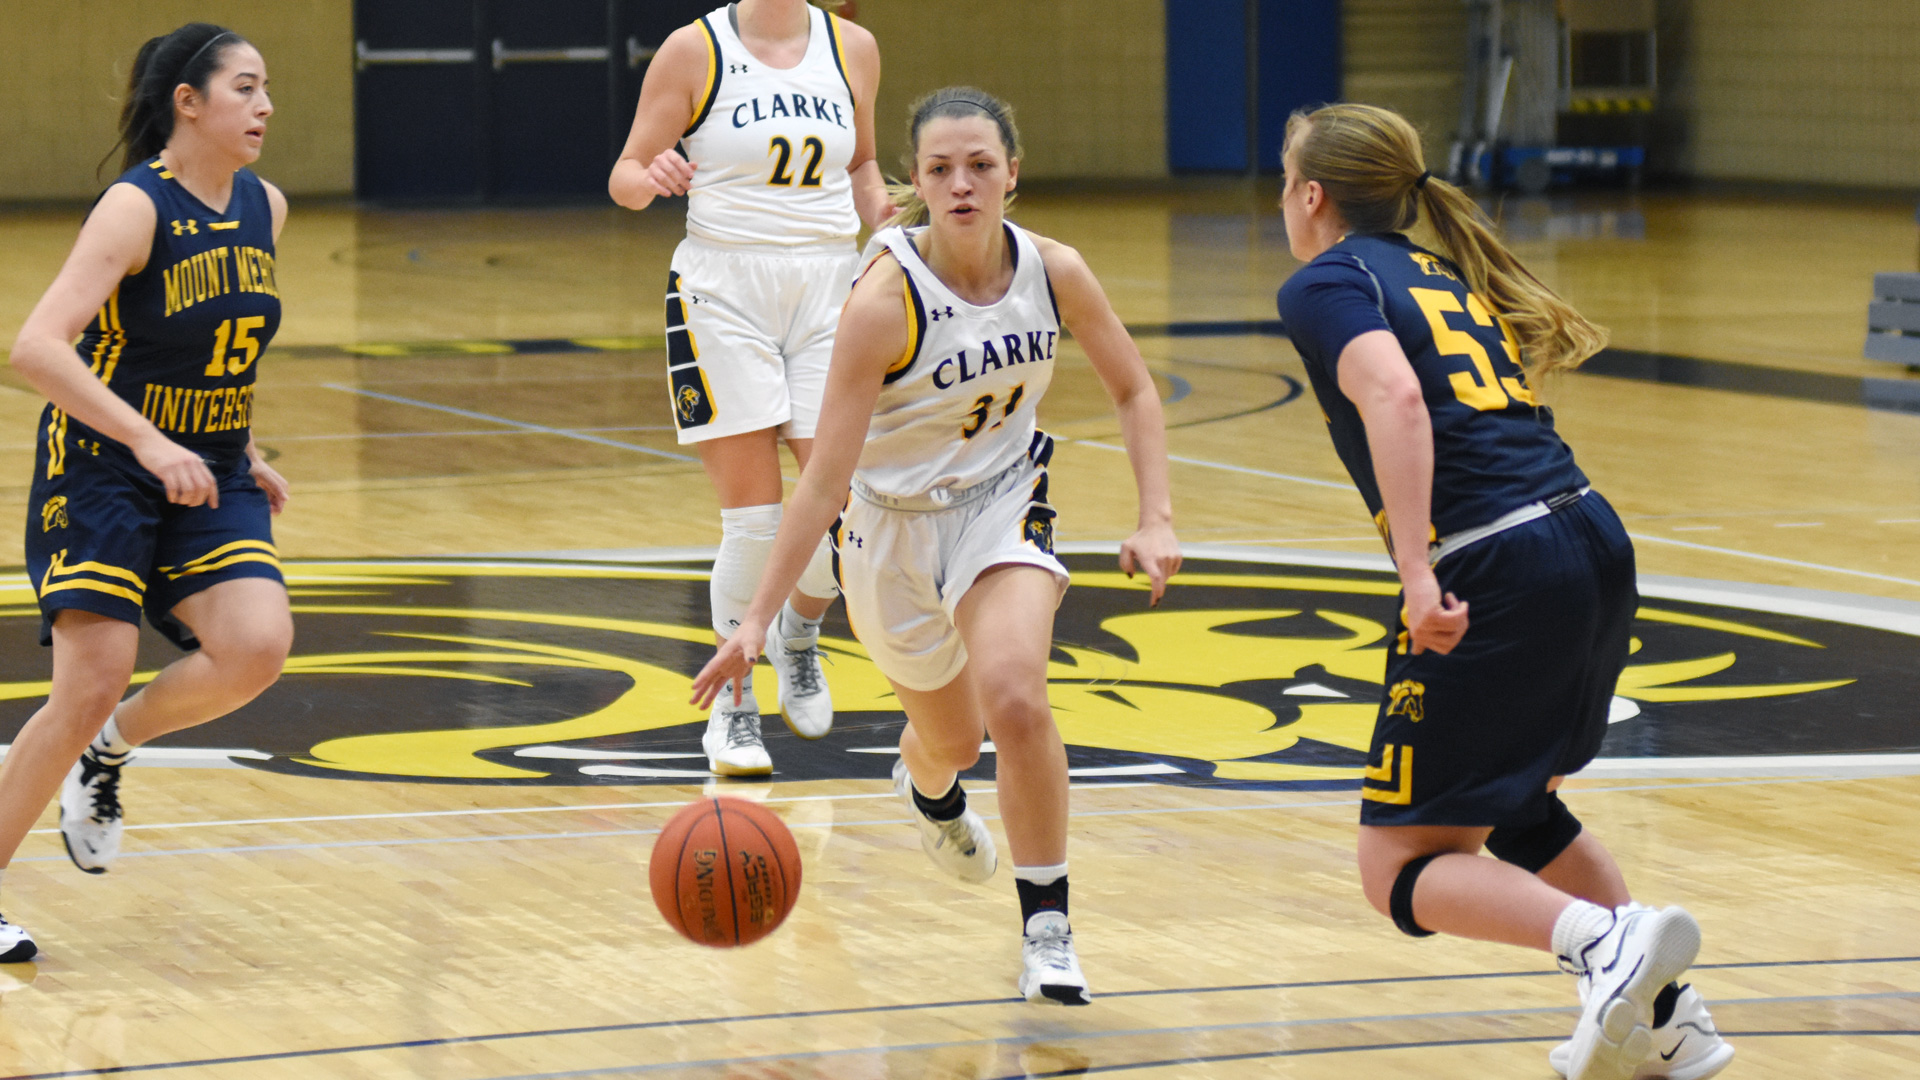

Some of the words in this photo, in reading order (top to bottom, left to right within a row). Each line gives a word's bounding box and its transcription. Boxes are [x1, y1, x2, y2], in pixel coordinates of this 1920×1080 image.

[732, 93, 848, 129] CLARKE
[766, 134, 825, 188] 22
[163, 246, 229, 317] MOUNT
[204, 315, 266, 376] 15
[932, 331, 1057, 390] CLARKE
[1408, 287, 1542, 412] 53
[962, 381, 1026, 442] 31
